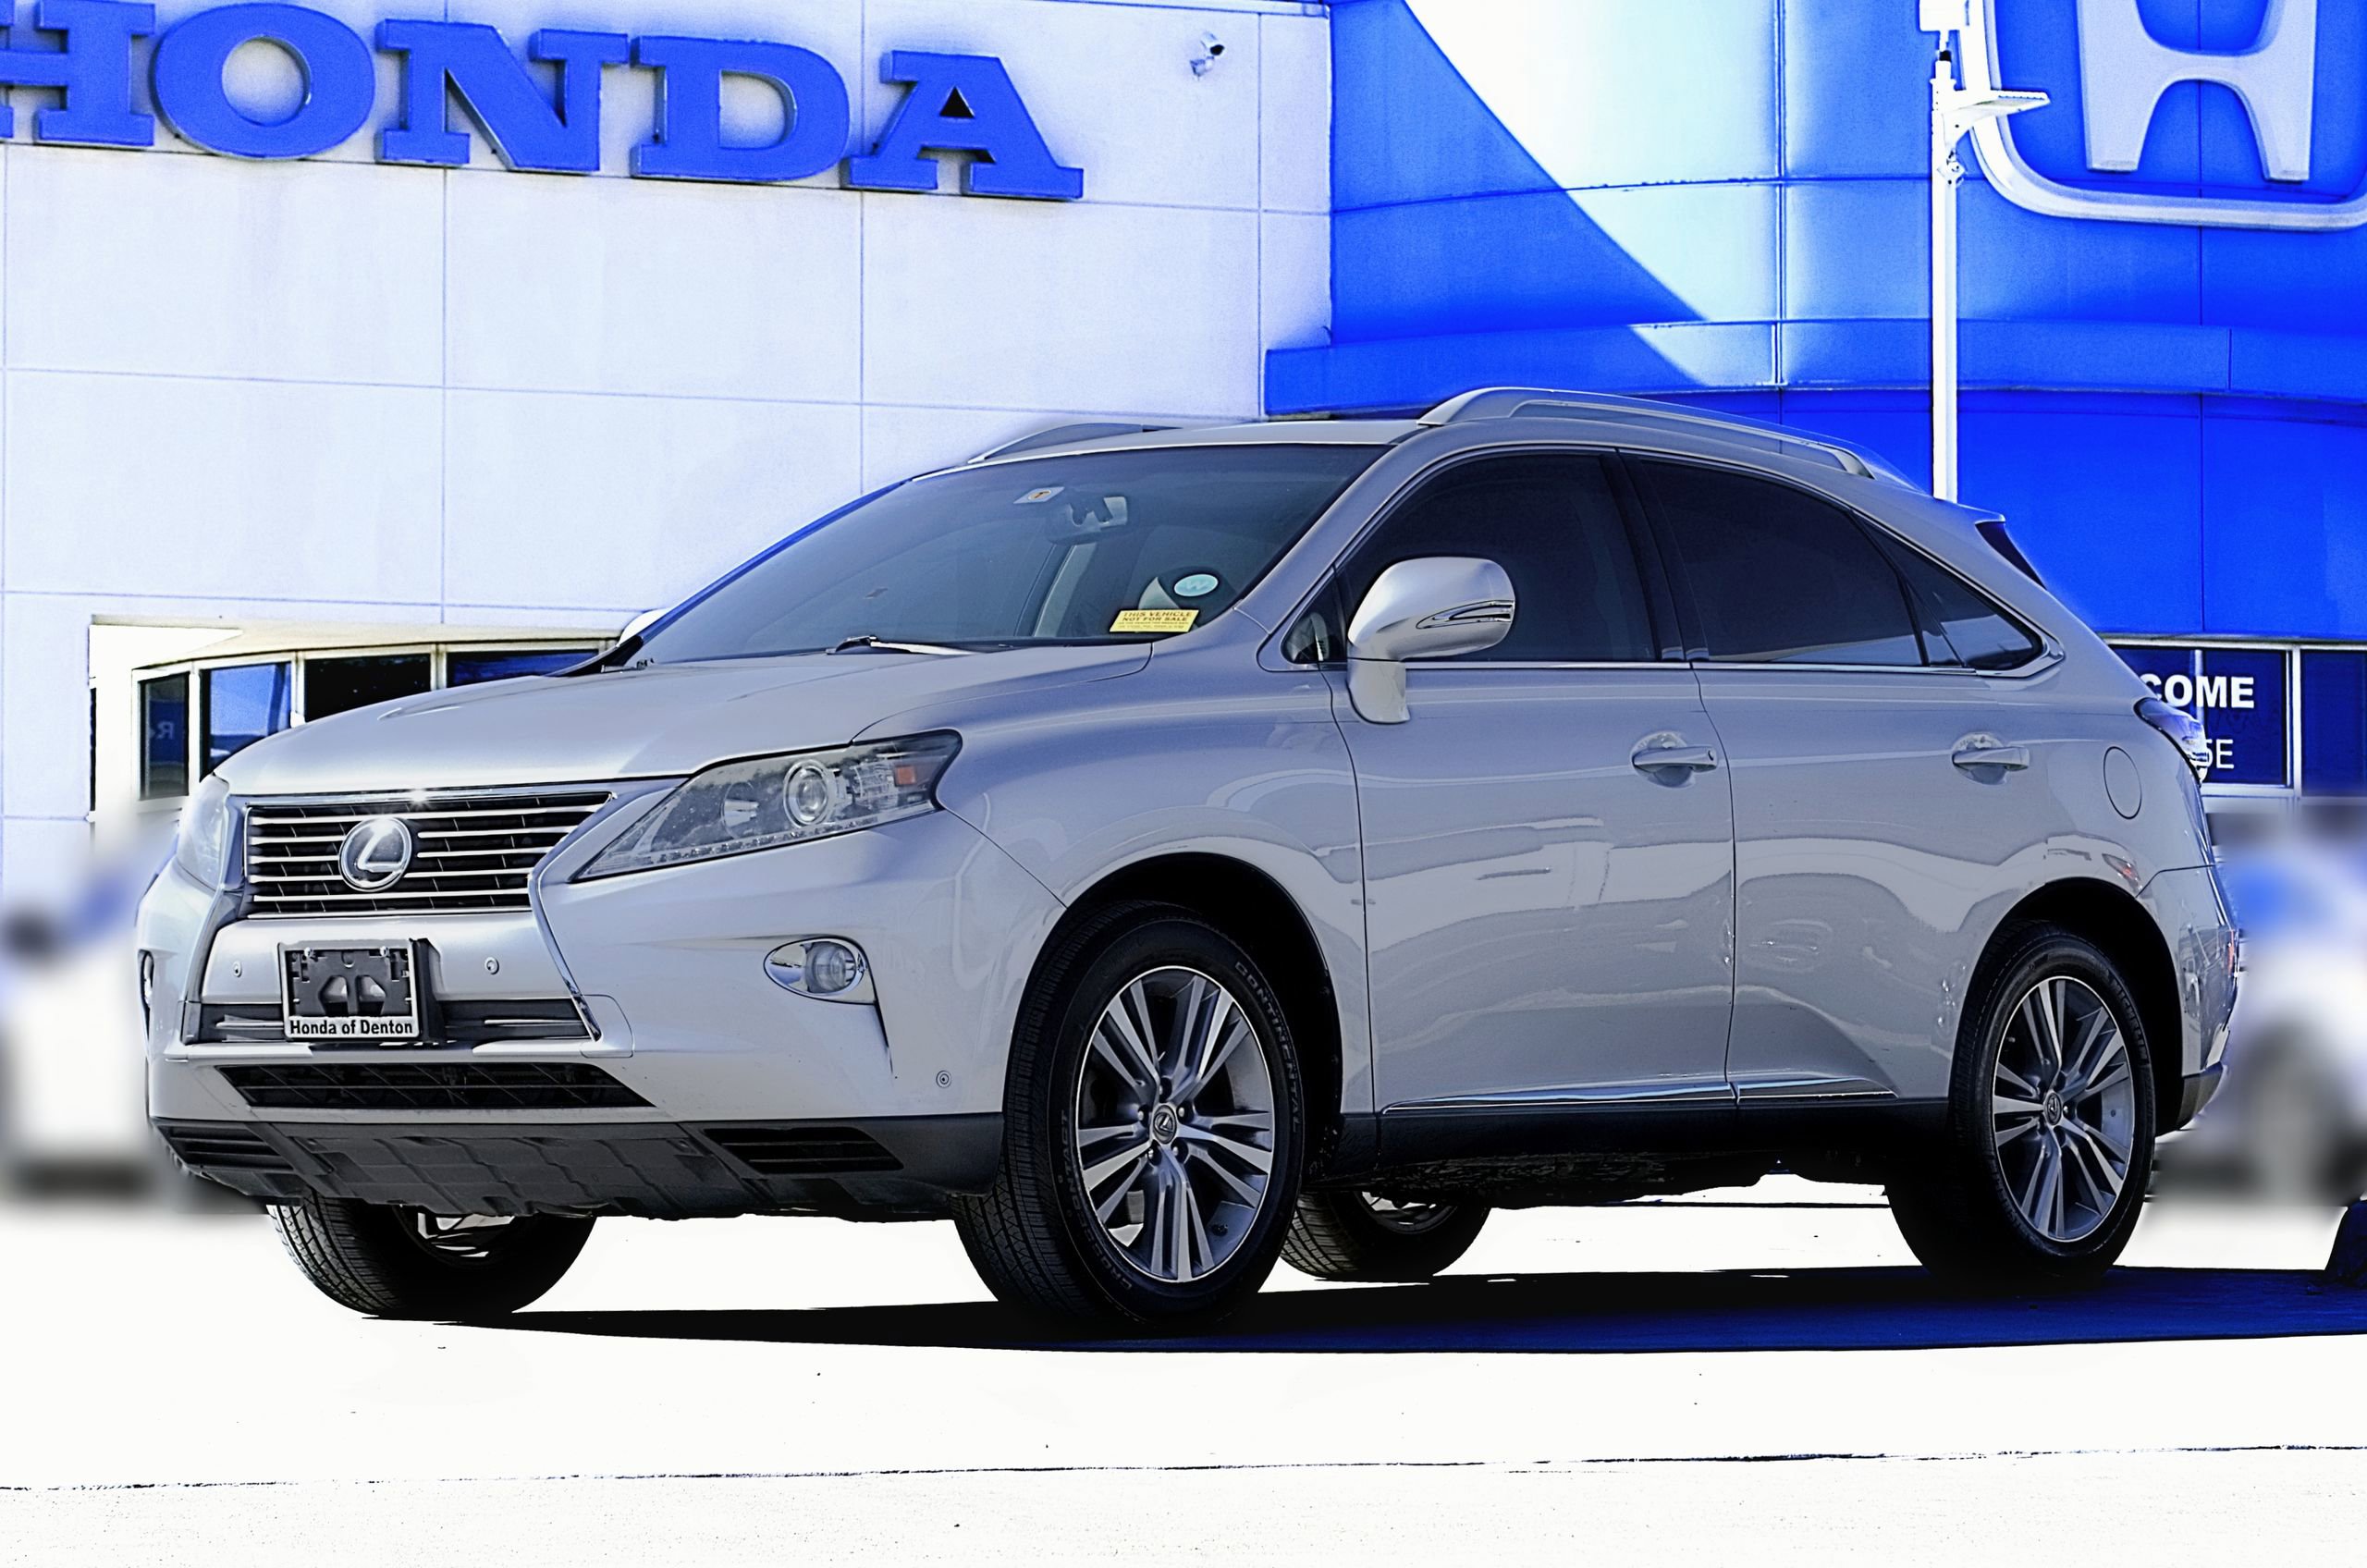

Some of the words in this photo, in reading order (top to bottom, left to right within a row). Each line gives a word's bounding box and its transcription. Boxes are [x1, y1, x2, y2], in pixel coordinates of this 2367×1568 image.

[0, 0, 1085, 200] HONDA
[290, 1020, 337, 1035] Honda
[341, 1020, 356, 1035] of
[361, 1020, 412, 1035] Denton
